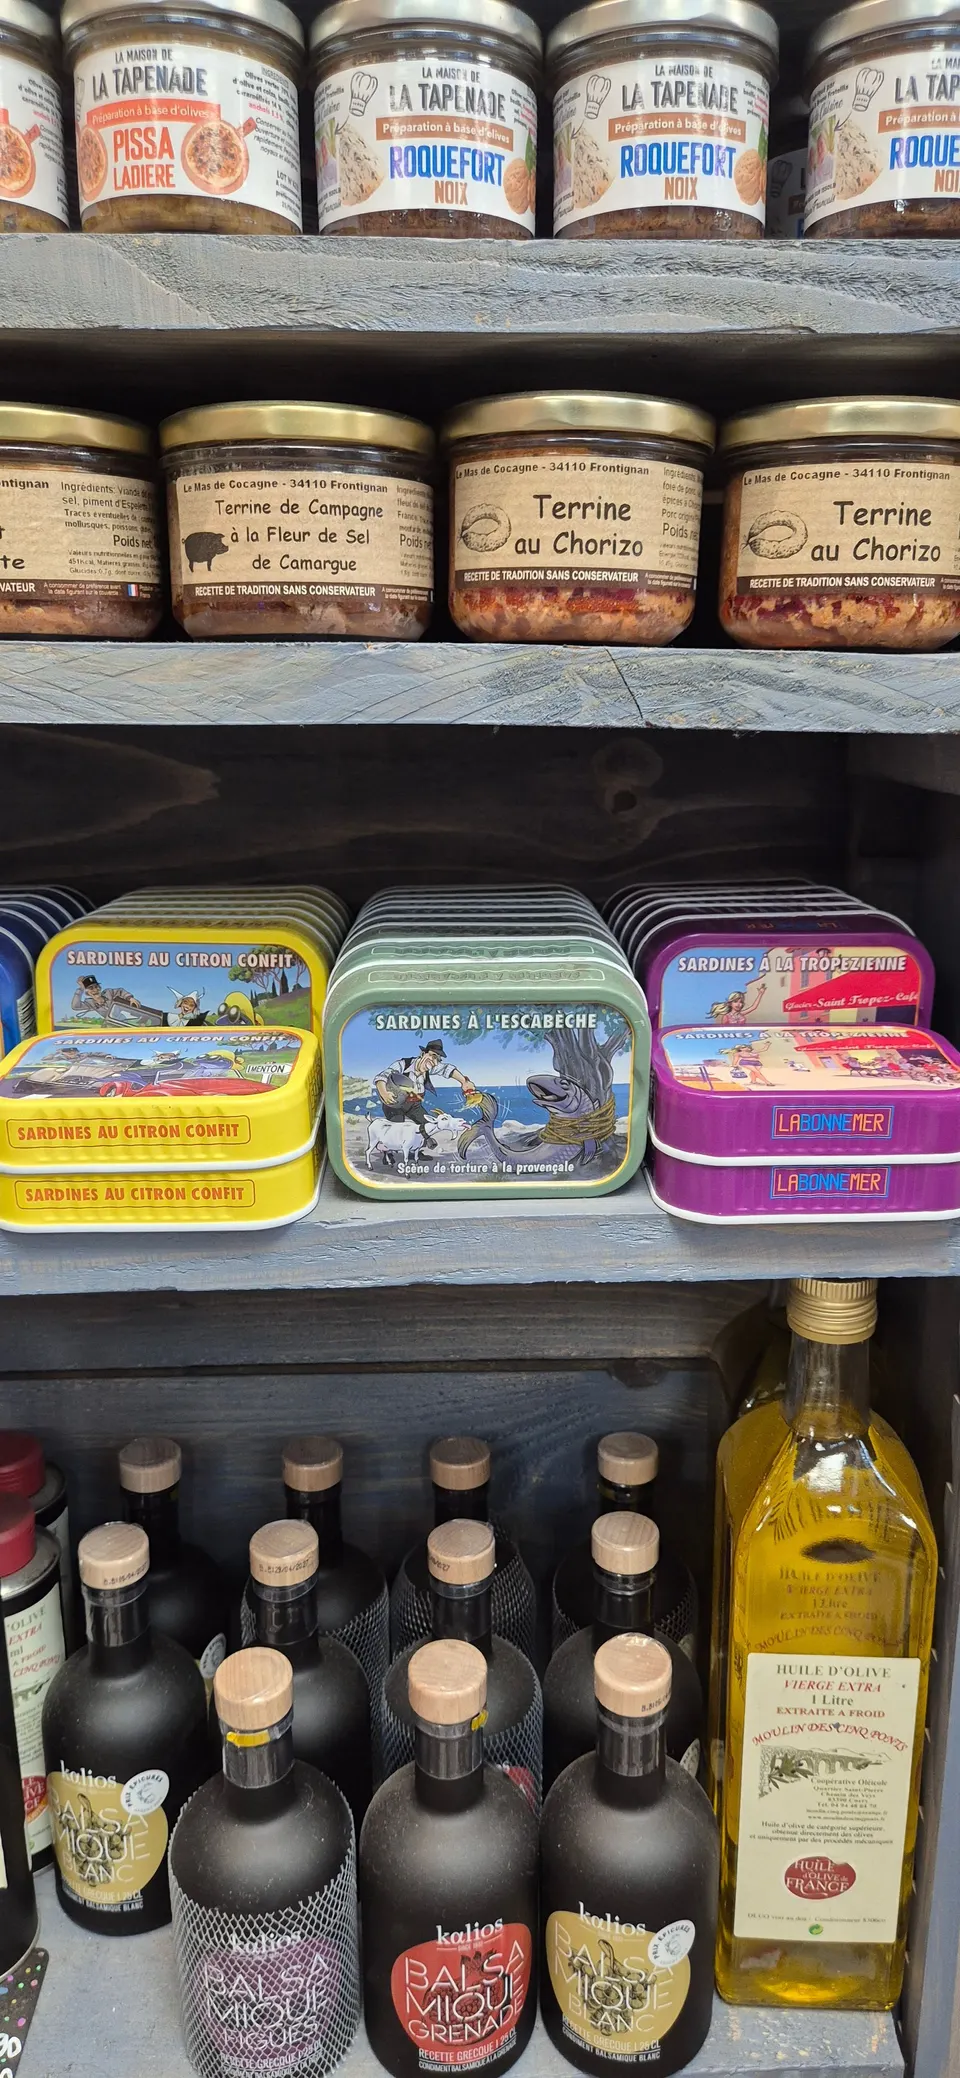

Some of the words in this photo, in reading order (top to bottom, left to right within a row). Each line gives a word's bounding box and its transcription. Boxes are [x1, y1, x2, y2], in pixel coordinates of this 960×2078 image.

[115, 51, 124, 64] LA
[126, 49, 158, 62] MAISON
[162, 48, 173, 60] DE
[422, 66, 432, 78] LA
[470, 70, 480, 83] DE
[655, 64, 665, 76] LA
[668, 64, 702, 78] MAISON
[704, 65, 713, 79] DE
[92, 74, 109, 101] LA
[112, 66, 208, 98] TAPENADE
[894, 76, 919, 104] LA
[390, 84, 414, 112] LA
[418, 83, 506, 122] TAPENADE
[622, 84, 646, 111] LA
[650, 80, 739, 114] TAPENADE
[92, 107, 135, 125] Préparation
[145, 104, 168, 117] base
[170, 105, 210, 119] d'olives
[886, 112, 948, 128] Préparation
[382, 122, 443, 136] Préparation
[446, 122, 451, 132] à
[454, 122, 476, 136] base
[478, 125, 510, 145] d'olives
[614, 118, 675, 134] Préparation
[676, 118, 682, 128] à
[684, 119, 708, 132] base
[708, 120, 742, 136] d'olives
[113, 126, 175, 163] PISSA
[390, 145, 506, 187] ROQUEFORT
[620, 142, 736, 180] ROQUEFORT
[113, 164, 176, 192] LADIERE
[434, 180, 468, 206] NOIX
[664, 176, 698, 201] NOIX
[464, 468, 479, 479] Mas
[480, 466, 492, 476] de
[494, 464, 540, 478] Cocagne
[549, 462, 587, 474] 34110
[590, 462, 650, 478] Frontignan
[744, 476, 752, 487] Le
[754, 474, 772, 486] Mas
[774, 472, 786, 484] de
[790, 469, 841, 484] Cocagne
[852, 468, 891, 480] 34110
[894, 468, 950, 482] Frontignan
[60, 481, 116, 494] Ingrédients:
[184, 484, 192, 494] Le
[194, 482, 212, 493] Mas
[214, 480, 226, 491] de
[228, 479, 279, 492] Cocagne
[290, 479, 327, 492] 34110
[330, 480, 388, 496] Frontignan
[83, 498, 113, 508] piment
[215, 498, 272, 516] Terrine
[280, 498, 300, 516] de
[308, 498, 384, 522] Campagne
[532, 494, 632, 522] Terrine
[64, 508, 91, 518] Traces
[833, 500, 932, 528] Terrine
[230, 527, 240, 544] à
[246, 526, 260, 544] la
[268, 526, 312, 545] Fleur
[318, 528, 338, 545] de
[346, 528, 370, 545] Sel
[662, 522, 688, 540] Poids
[113, 534, 140, 548] Poids
[400, 534, 424, 548] Poids
[514, 537, 540, 556] au
[553, 530, 644, 558] Chorizo
[811, 544, 840, 562] au
[852, 536, 942, 564] Chorizo
[252, 554, 272, 572] de
[280, 554, 358, 576] Camargue
[464, 570, 491, 582] RECETTE
[491, 570, 501, 581] DE
[502, 570, 545, 582] TRADITION
[546, 570, 570, 580] SANS
[572, 570, 640, 584] CONSERVATEUR
[750, 578, 782, 590] RECETTE
[782, 577, 794, 588] DE
[796, 576, 844, 588] TRADITION
[844, 577, 870, 588] SANS
[870, 577, 936, 588] CONSERVATEUR
[194, 586, 224, 598] RECETTE
[224, 586, 236, 597] DE
[236, 584, 282, 596] TRADITION
[282, 585, 308, 596] SANS
[310, 586, 376, 598] CONSERVATEUR
[67, 950, 143, 967] SARDINES
[148, 950, 170, 968] AU
[176, 951, 232, 968] CITRON
[237, 952, 293, 970] CONFIT
[678, 956, 755, 972] SARDINES
[759, 953, 772, 972] À
[776, 956, 794, 972] LA
[800, 956, 907, 972] TROPEZIENNE
[375, 1014, 461, 1032] SARDINES
[467, 1009, 478, 1030] À
[486, 1008, 598, 1031] L'ESCABÈCHE
[54, 1036, 132, 1046] SARDINES
[138, 1036, 160, 1045] AU
[165, 1034, 224, 1044] CITRON
[228, 1034, 287, 1043] CONFIT
[18, 1126, 92, 1142] SARDINES
[98, 1125, 119, 1140] AU
[124, 1124, 181, 1140] CITRON
[186, 1123, 240, 1138] CONFIT
[397, 1160, 430, 1176] Scène
[433, 1162, 447, 1176] de
[450, 1162, 490, 1176] torture
[492, 1160, 500, 1174] à
[502, 1162, 514, 1174] la
[516, 1160, 575, 1177] provençale
[26, 1187, 100, 1204] SARDINES
[104, 1187, 125, 1202] AU
[130, 1186, 187, 1202] CITRON
[191, 1186, 246, 1201] CONFIT
[9, 1622, 42, 1646] EXTRA
[776, 1664, 823, 1678] HUILE
[828, 1665, 892, 1680] D'OLIVE
[784, 1680, 833, 1692] VIERGE
[838, 1681, 882, 1694] EXTRA
[822, 1694, 854, 1706] Litre
[776, 1706, 834, 1717] EXTRAITE
[838, 1709, 846, 1718] A
[849, 1709, 886, 1720] FROID
[752, 1724, 807, 1746] MOULIN
[808, 1722, 834, 1732] DES
[836, 1724, 869, 1740] CINQ
[870, 1730, 908, 1752] PONTS
[60, 1760, 117, 1790] kalios
[762, 1820, 780, 1829] Huile
[806, 1822, 815, 1831] de
[794, 1859, 835, 1872] HUILE
[786, 1877, 850, 1896] FRANCE
[578, 1901, 647, 1936] kalios
[436, 1916, 504, 1947] kalios
[408, 1997, 524, 2044] GRENADE
[569, 1992, 655, 2034] BLANC
[418, 2047, 455, 2062] RECETTE
[457, 2041, 494, 2062] GRECQUE
[500, 2034, 509, 2046] 25
[593, 2033, 632, 2053] GRECQUE
[650, 2040, 661, 2050] CL
[596, 2048, 638, 2063] BALSAMIQUE
[639, 2050, 661, 2062] BLANC
[418, 2061, 452, 2073] CONDIMENT
